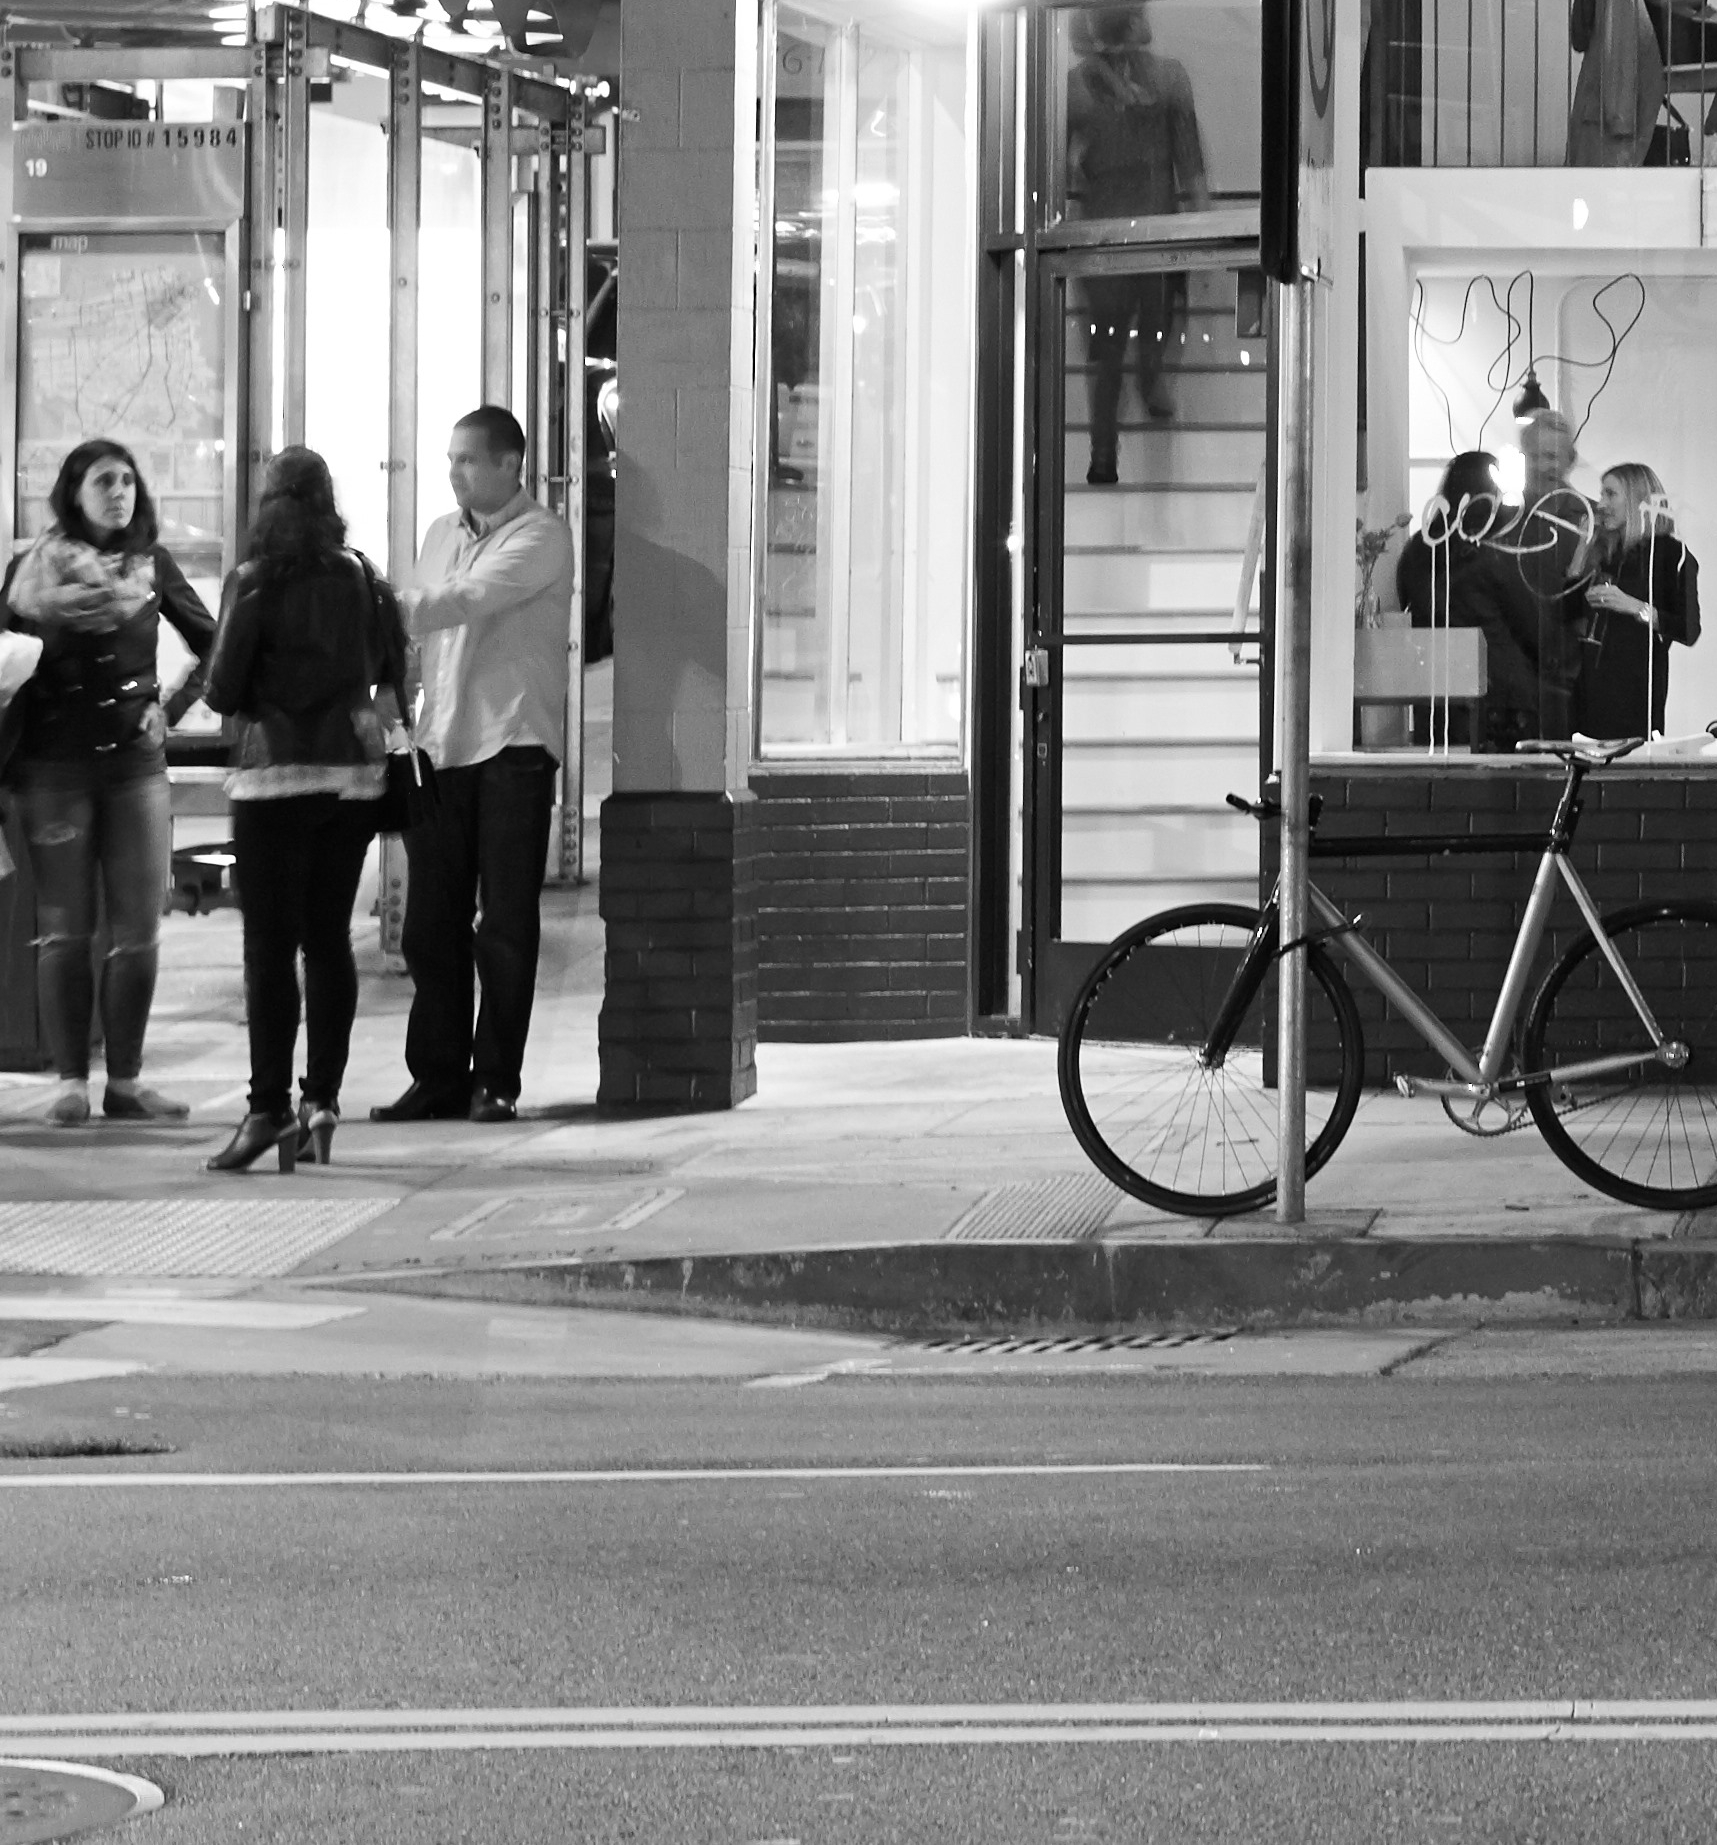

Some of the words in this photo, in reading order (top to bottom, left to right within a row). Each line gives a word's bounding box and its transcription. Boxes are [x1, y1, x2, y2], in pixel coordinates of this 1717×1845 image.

[86, 128, 123, 149] STOP
[128, 128, 141, 149] ID
[163, 127, 237, 148] 15984
[25, 158, 48, 178] 19
[51, 235, 89, 255] map
